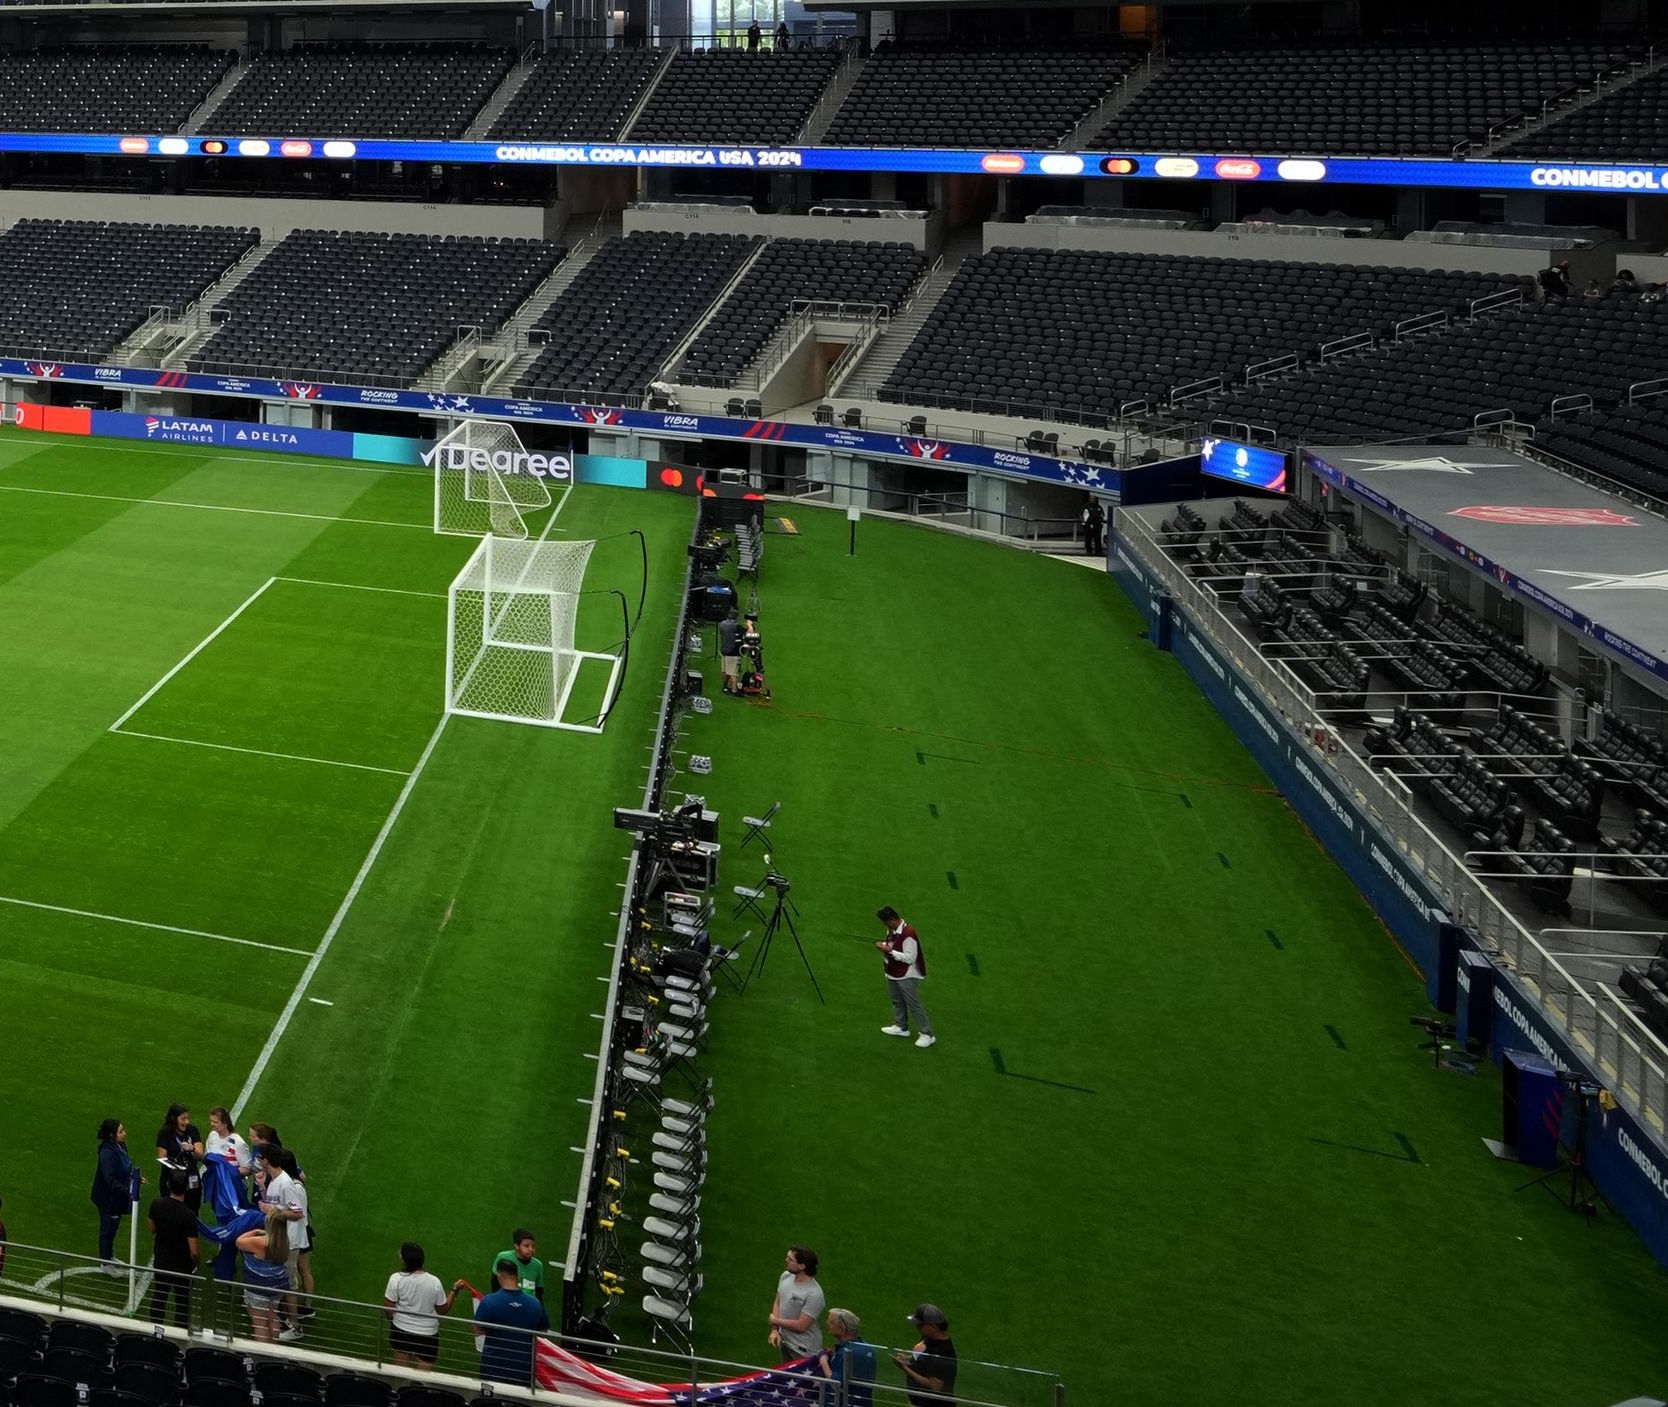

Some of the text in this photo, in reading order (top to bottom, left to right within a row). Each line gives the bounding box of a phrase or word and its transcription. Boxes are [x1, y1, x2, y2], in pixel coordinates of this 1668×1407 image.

[496, 146, 801, 165] CONMEBOL COPA AMERICA USA 2024
[1531, 168, 1660, 189] CONMEBOL
[361, 390, 399, 401] ROCKING
[664, 415, 699, 427] VIBRA
[162, 422, 214, 434] LATAM
[162, 432, 213, 443] AIRLINES
[252, 431, 298, 444] DELTA
[448, 445, 570, 479] Degree
[994, 452, 1031, 465] ROCKING
[1618, 1127, 1662, 1192] CONMEBOL
